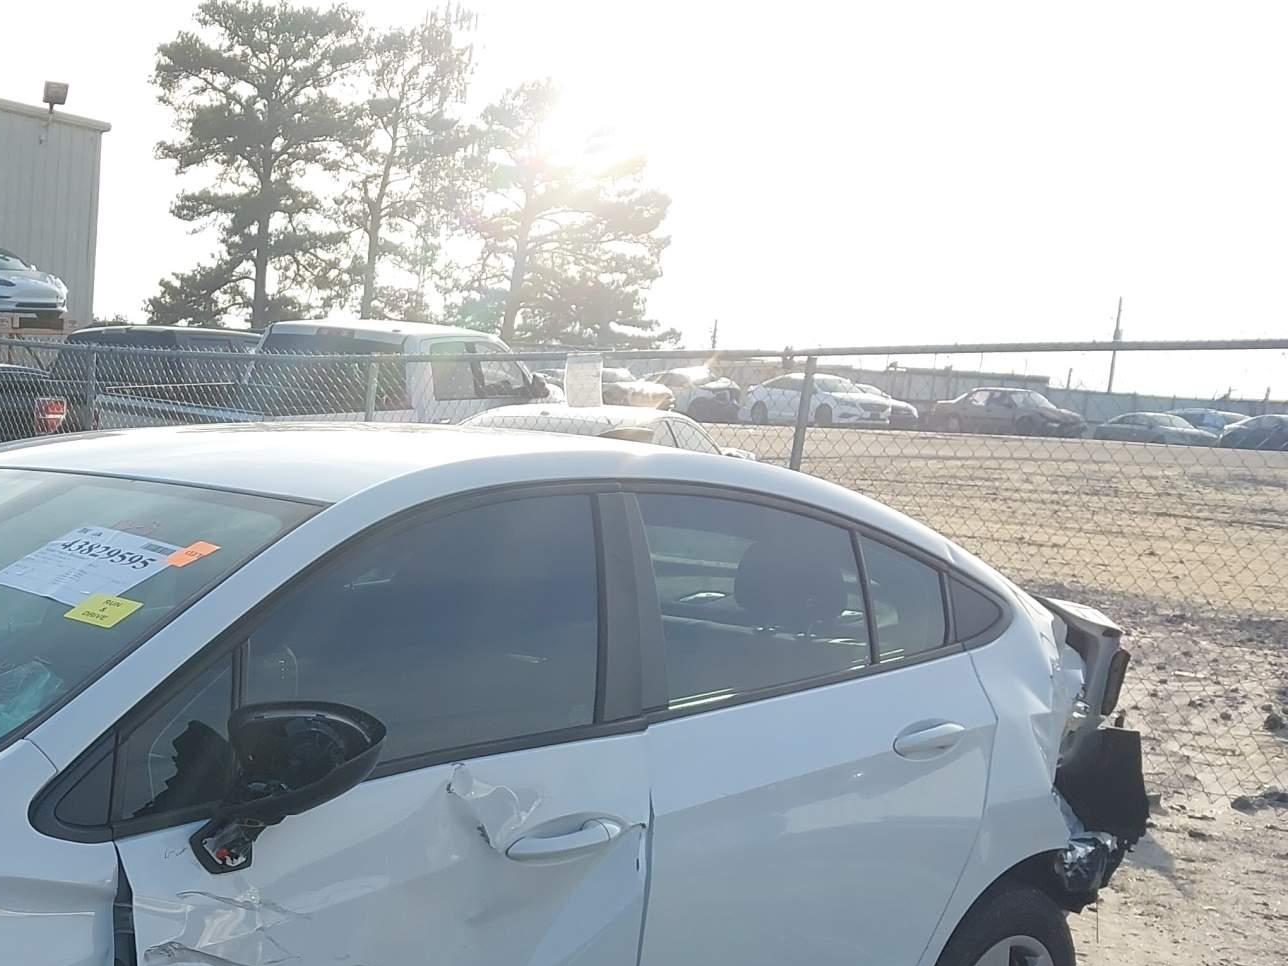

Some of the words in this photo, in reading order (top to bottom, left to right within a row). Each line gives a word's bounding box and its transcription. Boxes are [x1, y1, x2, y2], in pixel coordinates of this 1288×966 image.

[60, 538, 158, 570] 43829595
[103, 599, 124, 608] RUN
[81, 610, 109, 621] DRIVE
